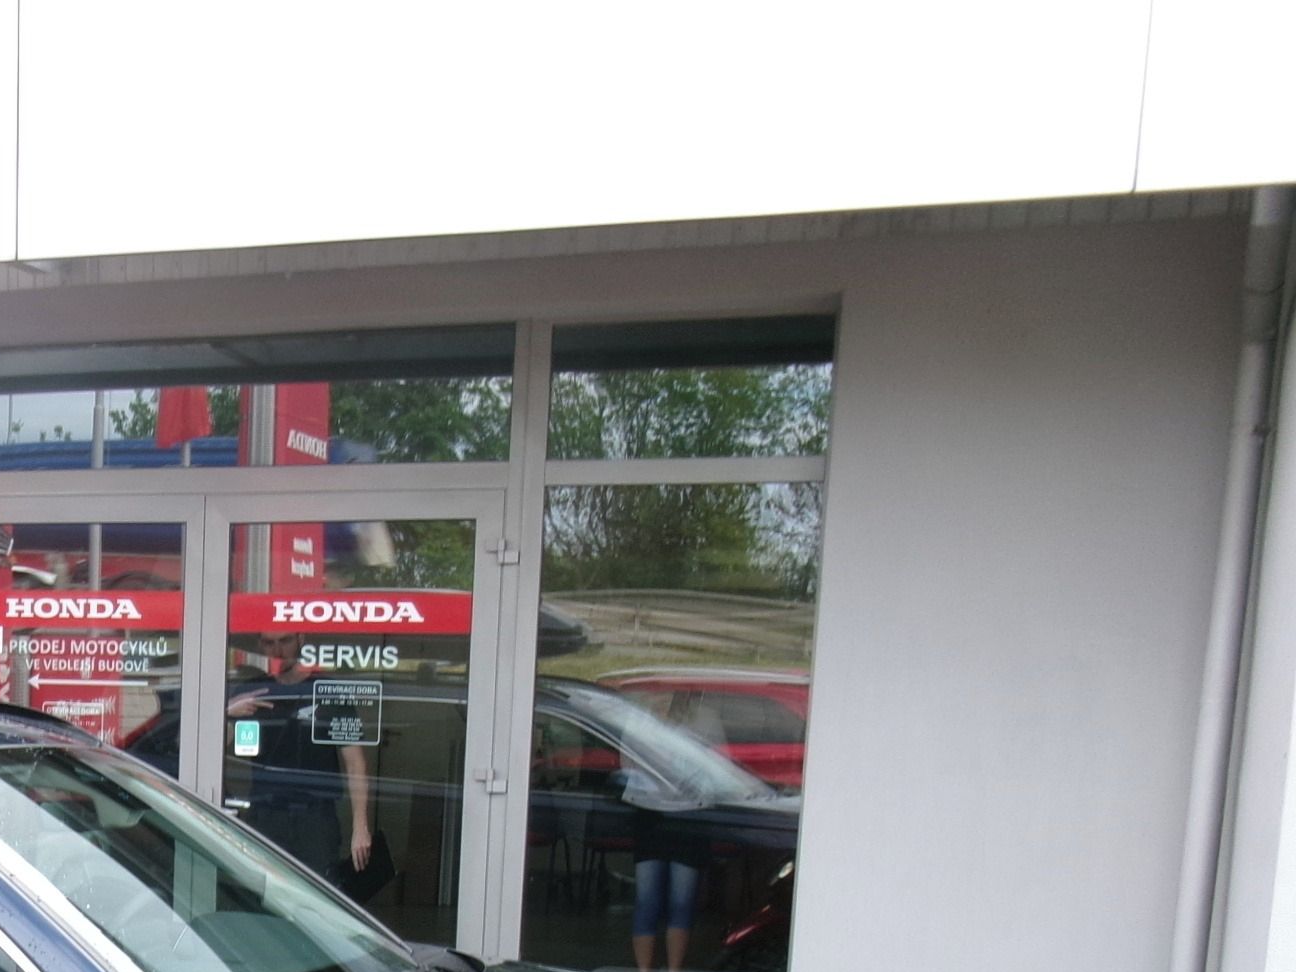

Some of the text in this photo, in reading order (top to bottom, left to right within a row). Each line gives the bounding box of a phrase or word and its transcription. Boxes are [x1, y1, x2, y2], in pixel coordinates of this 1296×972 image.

[5, 597, 142, 620] HONDA
[272, 601, 425, 623] HONDA
[9, 637, 168, 656] PRODEJ MOTOCYKLŮ
[300, 644, 399, 669] SERVIS
[26, 656, 149, 673] VE VEDLEJŠÍ BUDOVĚ
